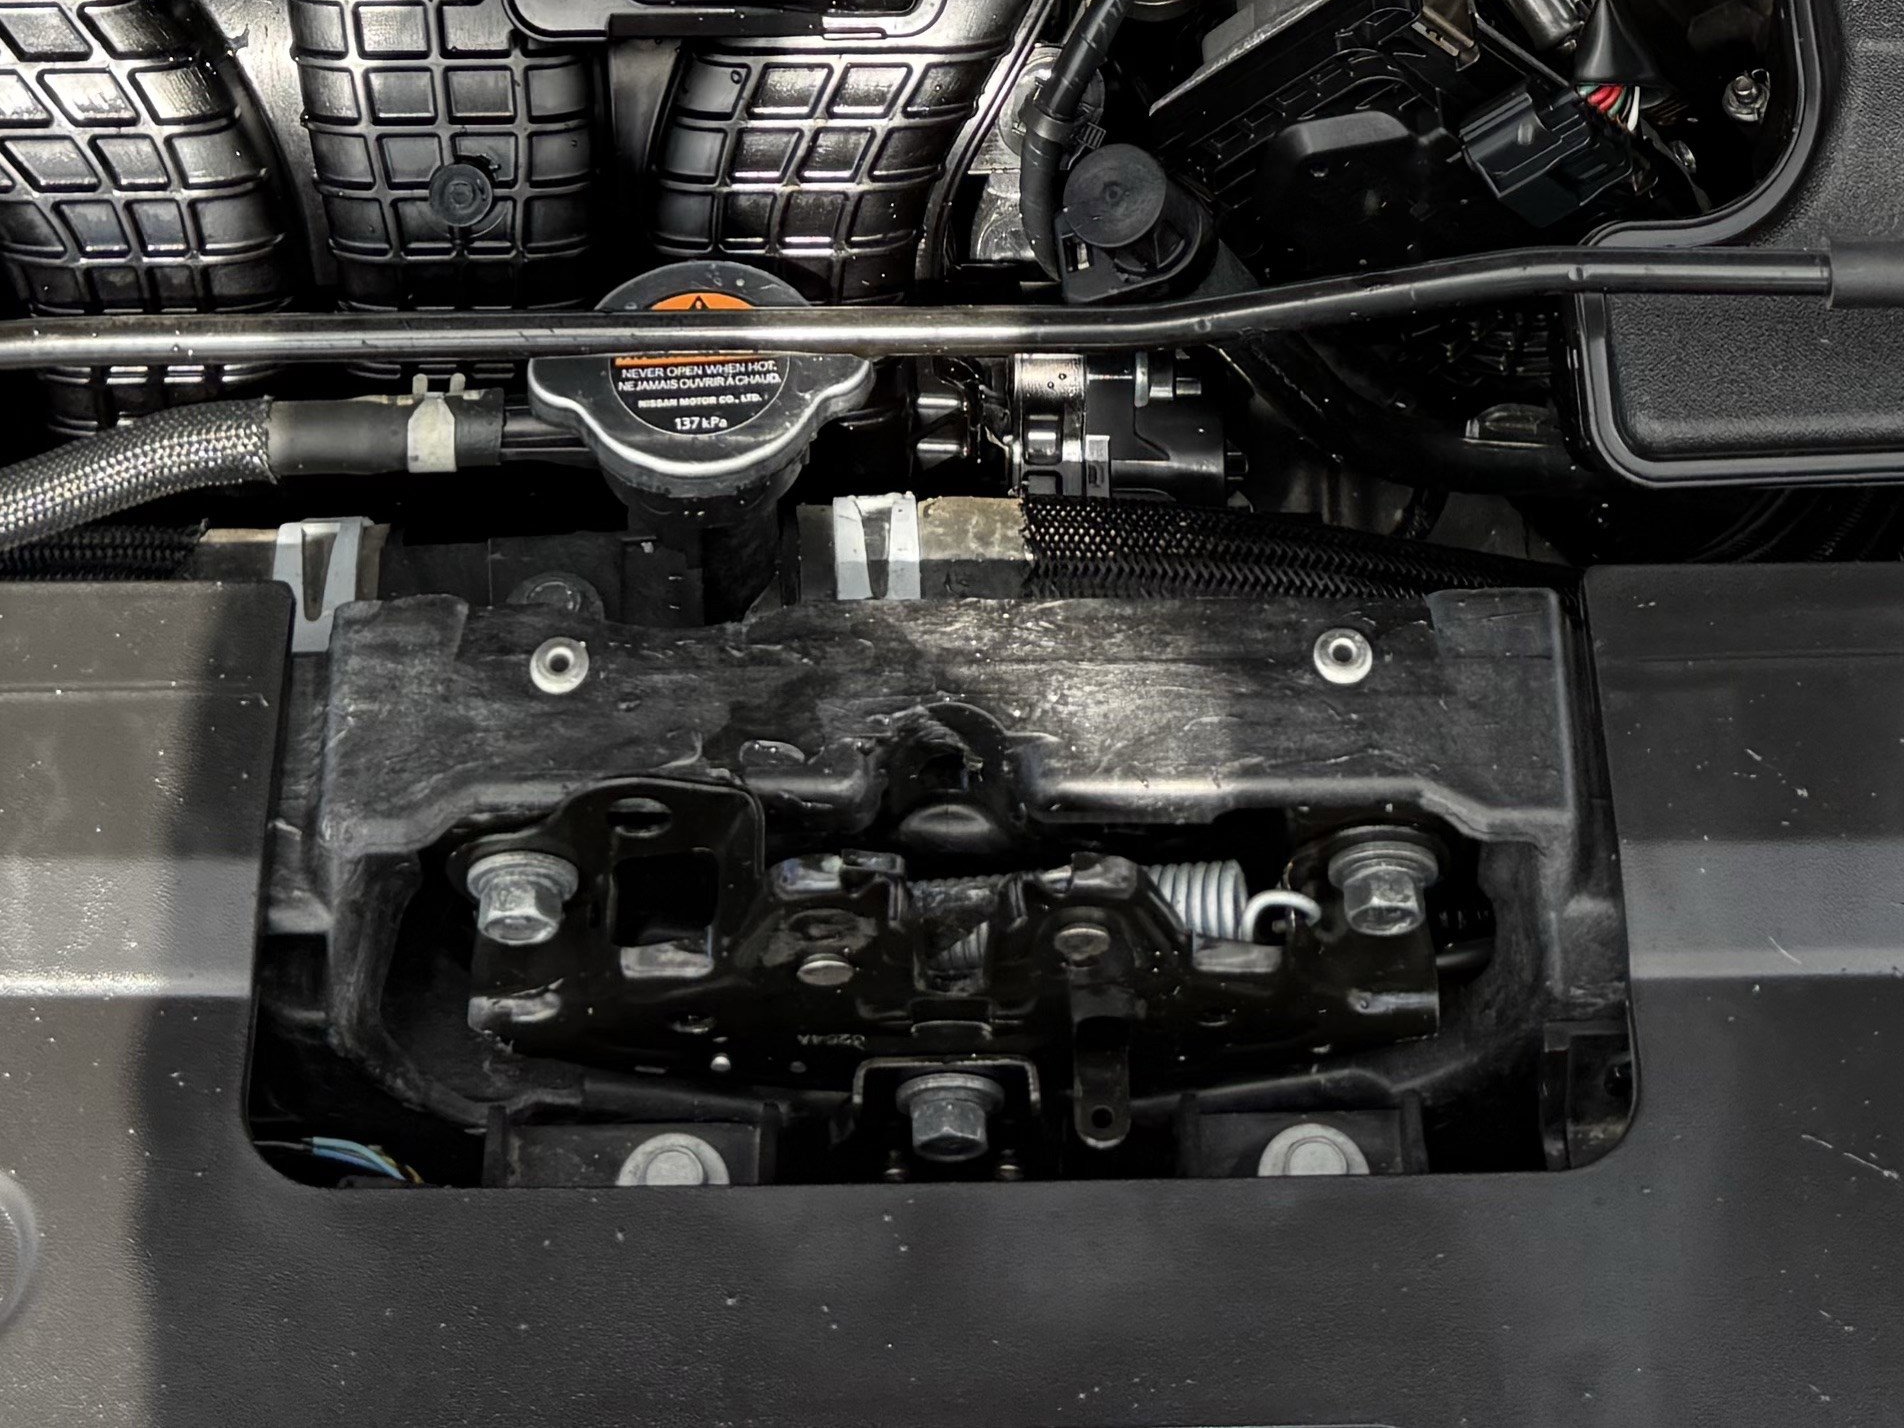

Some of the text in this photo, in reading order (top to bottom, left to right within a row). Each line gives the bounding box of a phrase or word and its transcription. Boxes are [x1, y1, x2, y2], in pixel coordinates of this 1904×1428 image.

[621, 360, 778, 378] NEVER OPEN WHEN HOT.
[618, 381, 635, 392] NE
[636, 378, 678, 391] JAMAIS
[679, 376, 725, 388] OUVRIR
[638, 399, 677, 408] NISSAN
[679, 397, 717, 407] MOTOR
[674, 417, 728, 430] 137 kPa
